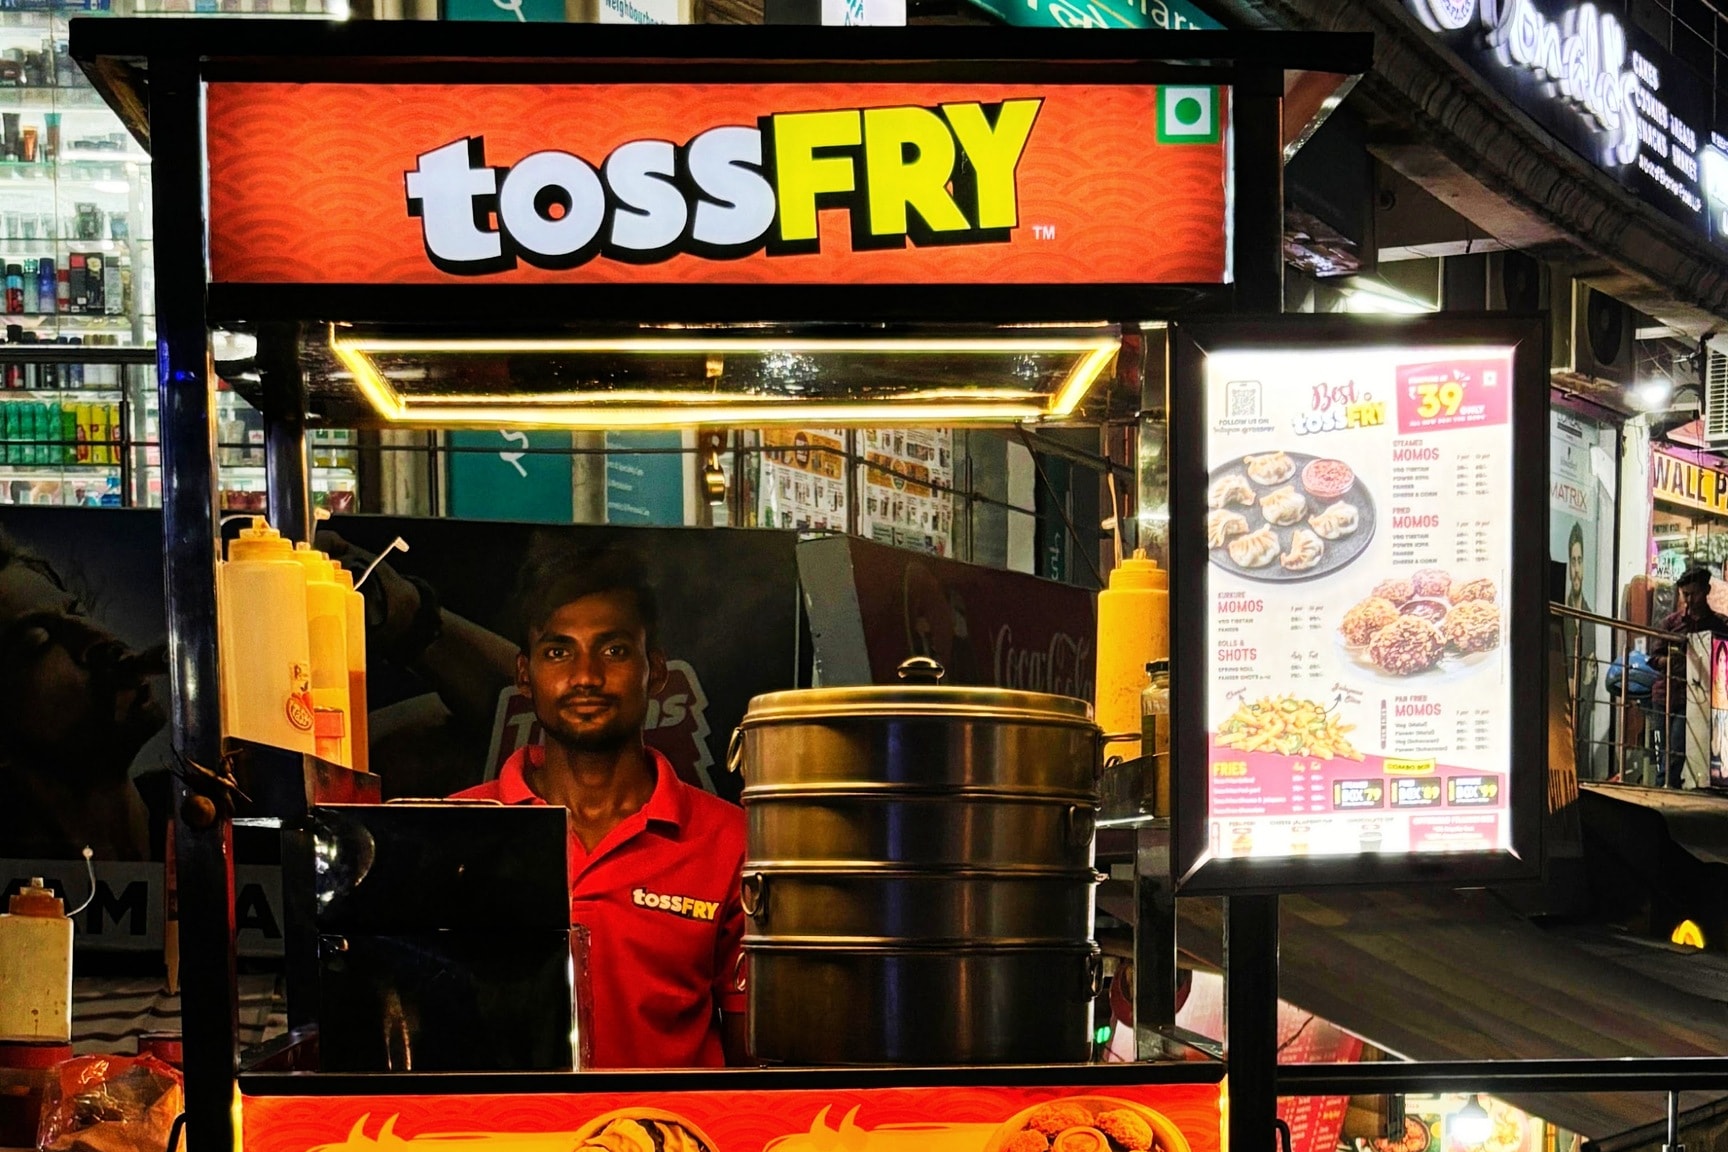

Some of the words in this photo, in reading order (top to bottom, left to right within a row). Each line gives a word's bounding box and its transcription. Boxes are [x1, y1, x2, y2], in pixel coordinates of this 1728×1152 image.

[404, 97, 1044, 275] tossFRY
[1393, 447, 1440, 462] MOMOS
[1653, 455, 1707, 503] WALL
[1393, 515, 1439, 529] MOMOS
[1218, 600, 1264, 614] MOMOS
[1218, 648, 1257, 662] SHOTS
[1395, 703, 1442, 717] MOMOS
[632, 887, 720, 921] tossFRY
